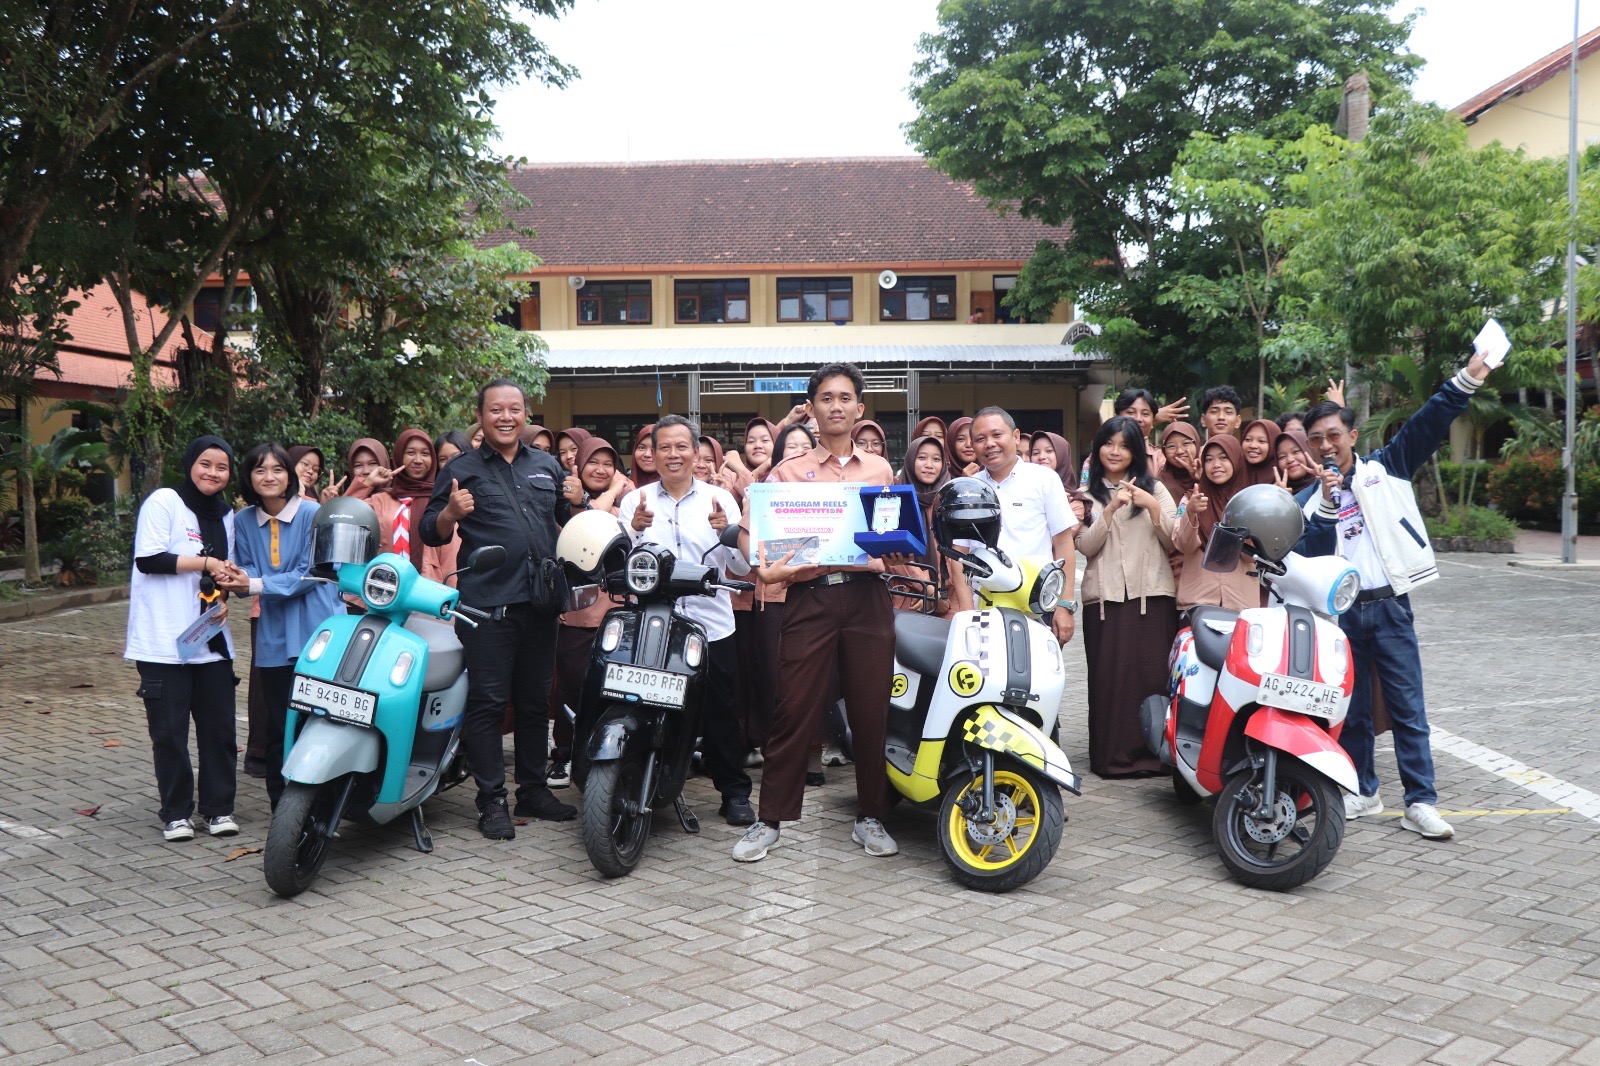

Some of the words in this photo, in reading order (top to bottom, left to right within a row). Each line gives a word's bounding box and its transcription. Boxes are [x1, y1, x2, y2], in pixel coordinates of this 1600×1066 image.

[770, 500, 821, 508] INSTAGRAM
[822, 500, 848, 508] REELS
[607, 667, 624, 681] AG
[627, 670, 658, 686] 2303
[660, 676, 684, 692] RFR
[1263, 676, 1280, 691] AG
[1285, 681, 1316, 699] 9424
[1321, 688, 1339, 704] HE
[298, 681, 312, 696] AE
[316, 687, 348, 706] 9496
[354, 696, 369, 711] BG
